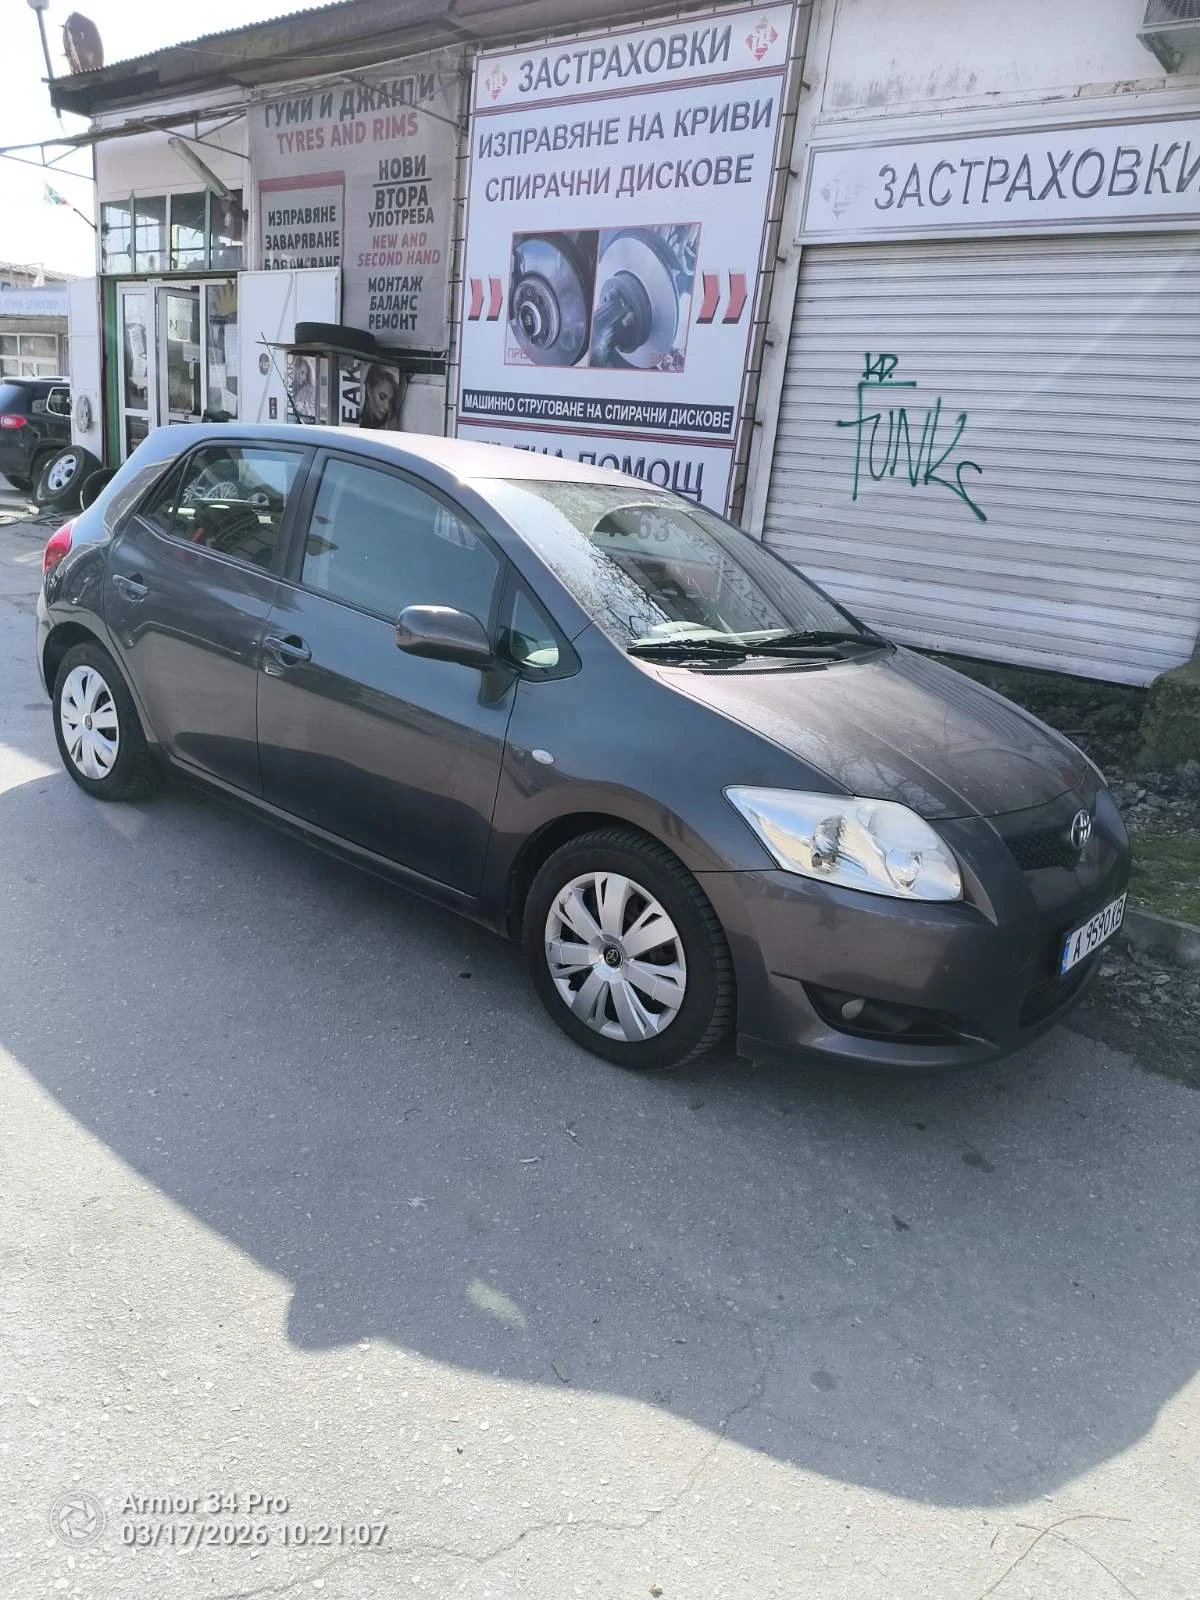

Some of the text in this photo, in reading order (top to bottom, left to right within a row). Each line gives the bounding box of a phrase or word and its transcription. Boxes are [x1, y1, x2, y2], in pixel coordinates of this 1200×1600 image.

[518, 25, 732, 93] ЗАСТРАХОВКИ
[265, 97, 313, 128] ГУМИ
[320, 93, 333, 118] И
[276, 112, 418, 154] TYRES AND RIMS
[478, 97, 774, 159] ИЗПРАВЯНЕ НА КРИВИ
[379, 154, 426, 181] НОВИ
[485, 153, 754, 203] СПИРАЧНИ ДИСКОВЕ
[375, 184, 429, 210] ВТОРА
[268, 205, 336, 227] ИЗПРАВЯНЕ
[368, 206, 434, 228] УПОТРЕБА
[265, 230, 340, 251] ЗАВАРЯВАНЕ
[372, 231, 427, 250] NEW AND
[357, 249, 441, 267] SECOND HAND
[368, 275, 423, 293] МОНТАЖ
[369, 294, 418, 312] БАЛАНС
[368, 313, 418, 331] РЕМОНТ
[464, 394, 731, 429] МАШИННО СТРУГОВАНЕ НА СПИРАЧНИ ДИСКОВЕ
